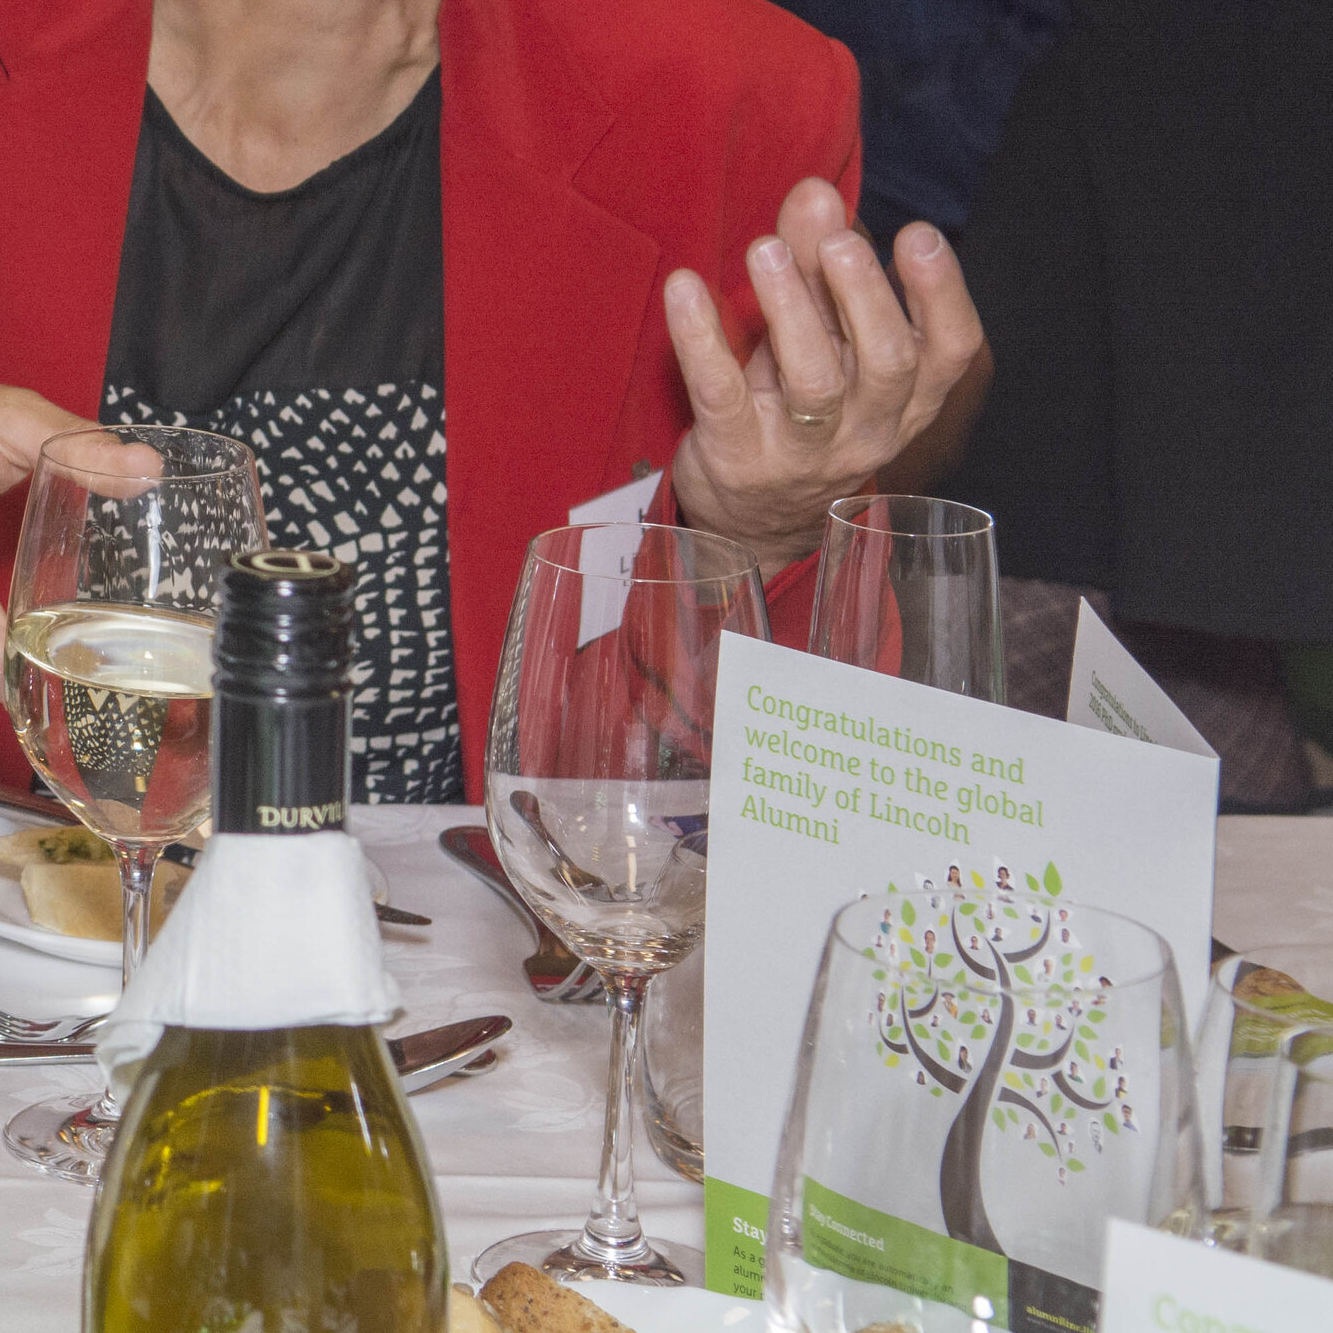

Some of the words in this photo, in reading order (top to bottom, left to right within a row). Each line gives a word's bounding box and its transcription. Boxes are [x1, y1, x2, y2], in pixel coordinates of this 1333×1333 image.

[747, 685, 962, 767] Congratulations
[971, 753, 1024, 785] and
[742, 757, 828, 808] family
[835, 788, 862, 813] of
[870, 792, 970, 845] Lincoln
[744, 726, 861, 776] welcome
[870, 757, 895, 785] to
[904, 767, 949, 801] the
[957, 784, 1044, 828] global
[740, 794, 840, 845] Alumni
[733, 1217, 767, 1246] Stay
[734, 1245, 746, 1260] As
[749, 1253, 755, 1263] a
[733, 1282, 757, 1298] your
